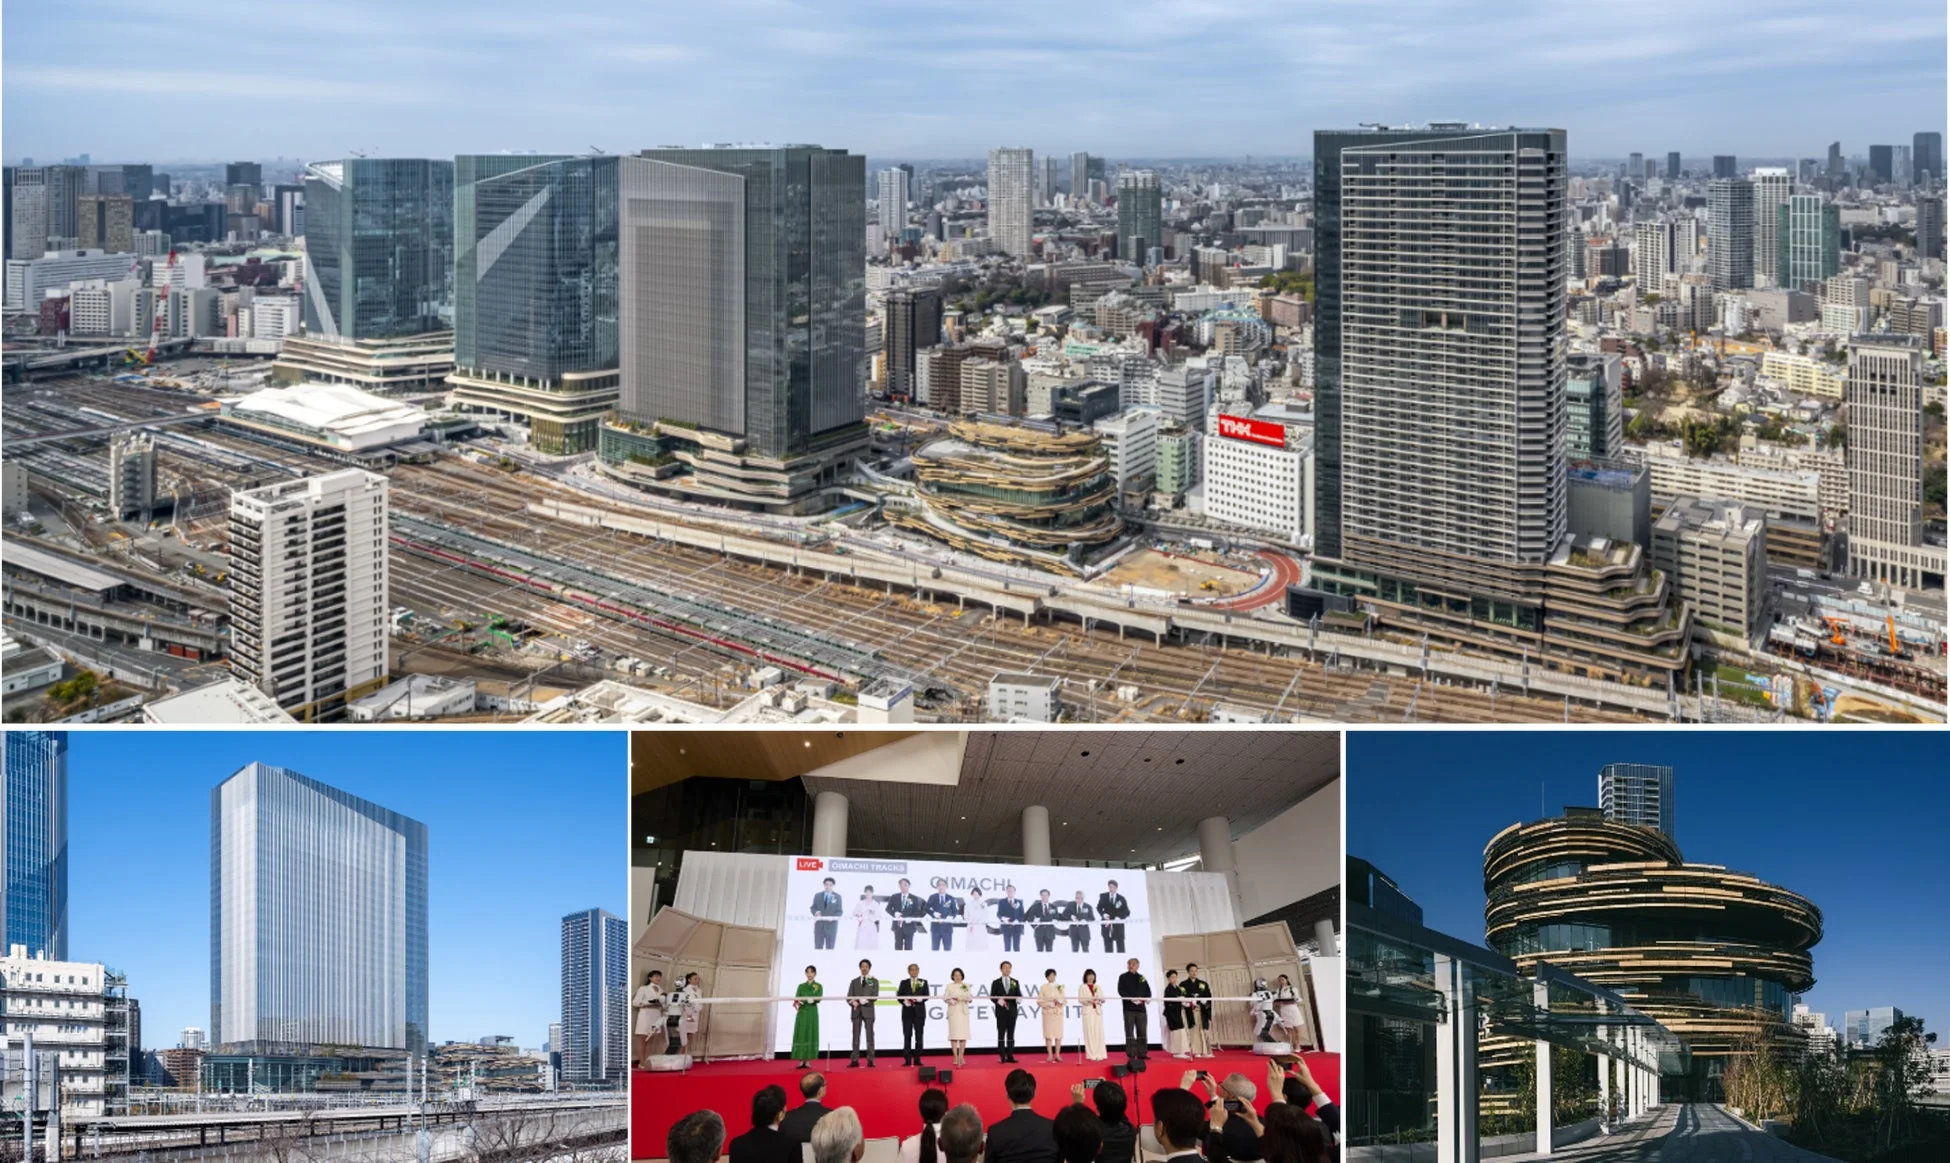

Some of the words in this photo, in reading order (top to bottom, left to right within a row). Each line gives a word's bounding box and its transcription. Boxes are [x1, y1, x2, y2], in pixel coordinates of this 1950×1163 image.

[1220, 418, 1252, 437] THK
[831, 862, 869, 871] OIMACHI
[871, 864, 905, 873] TRACKS
